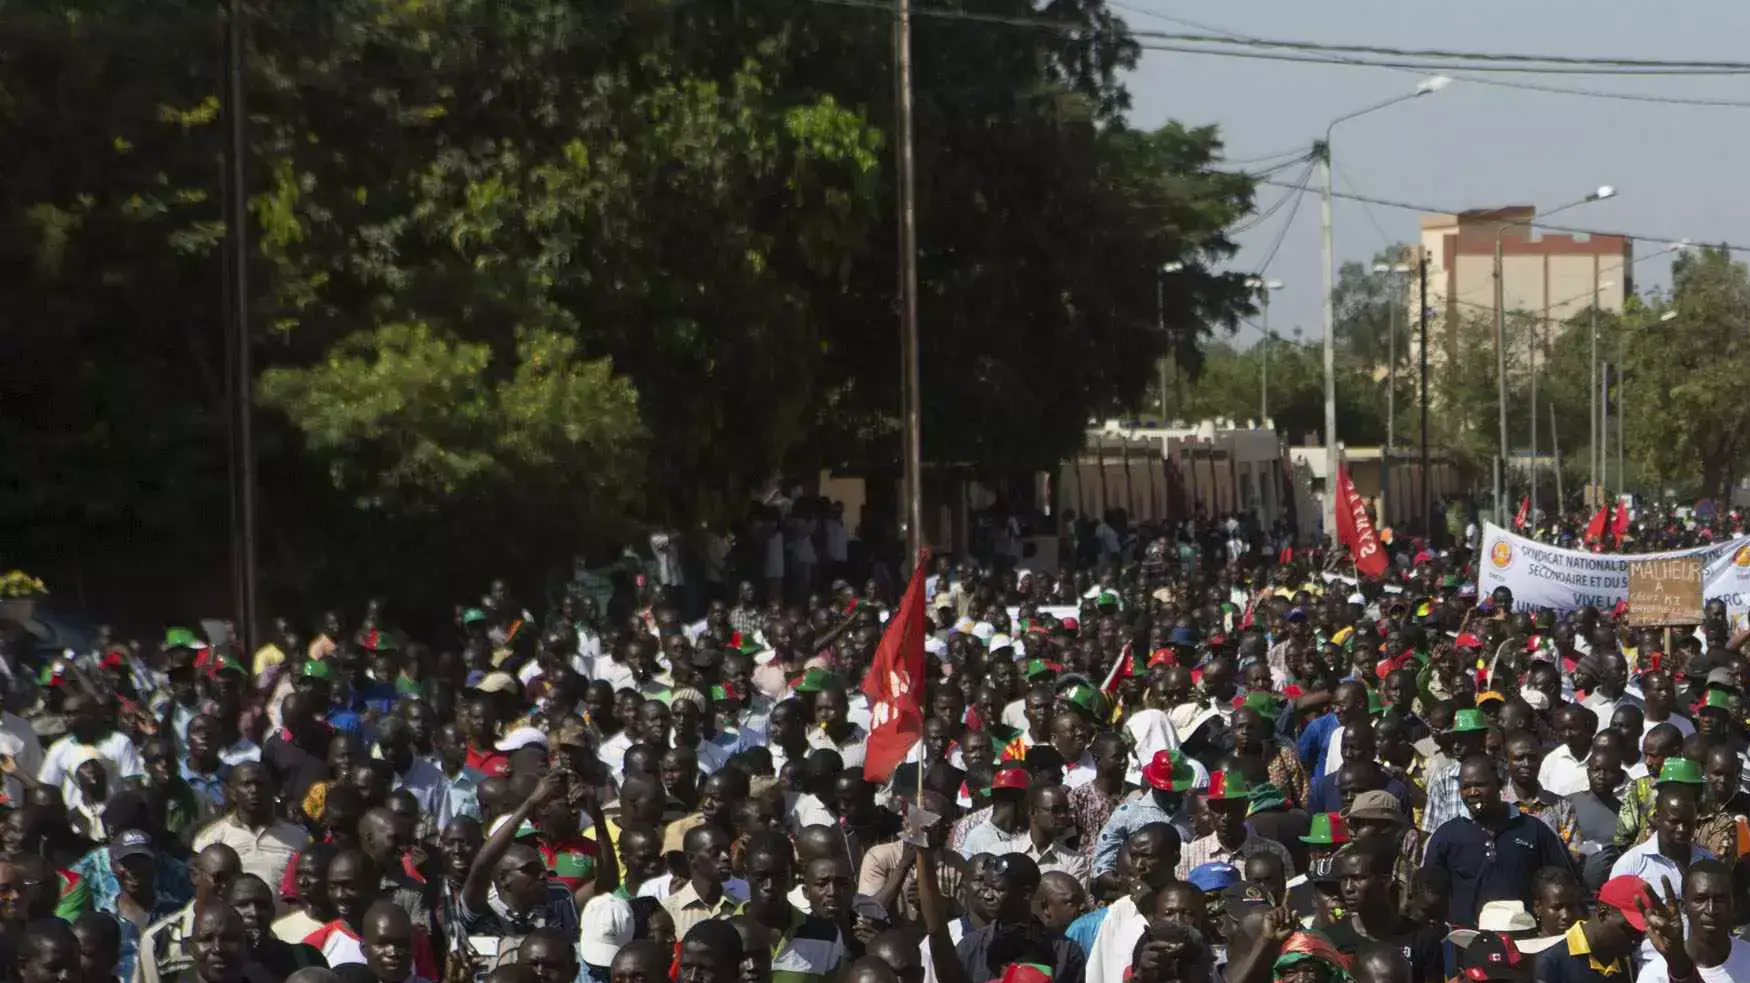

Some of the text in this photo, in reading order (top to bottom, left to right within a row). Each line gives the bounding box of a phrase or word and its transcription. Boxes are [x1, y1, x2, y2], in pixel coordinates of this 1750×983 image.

[1521, 545, 1563, 566] SYNDICAT
[1565, 555, 1616, 572] NATIONAL
[1528, 563, 1588, 586] SECONDAIRE
[1590, 577, 1601, 587] ET
[1604, 577, 1619, 589] DU
[1630, 560, 1701, 582] MALHEUR
[1573, 592, 1603, 608] VIVE
